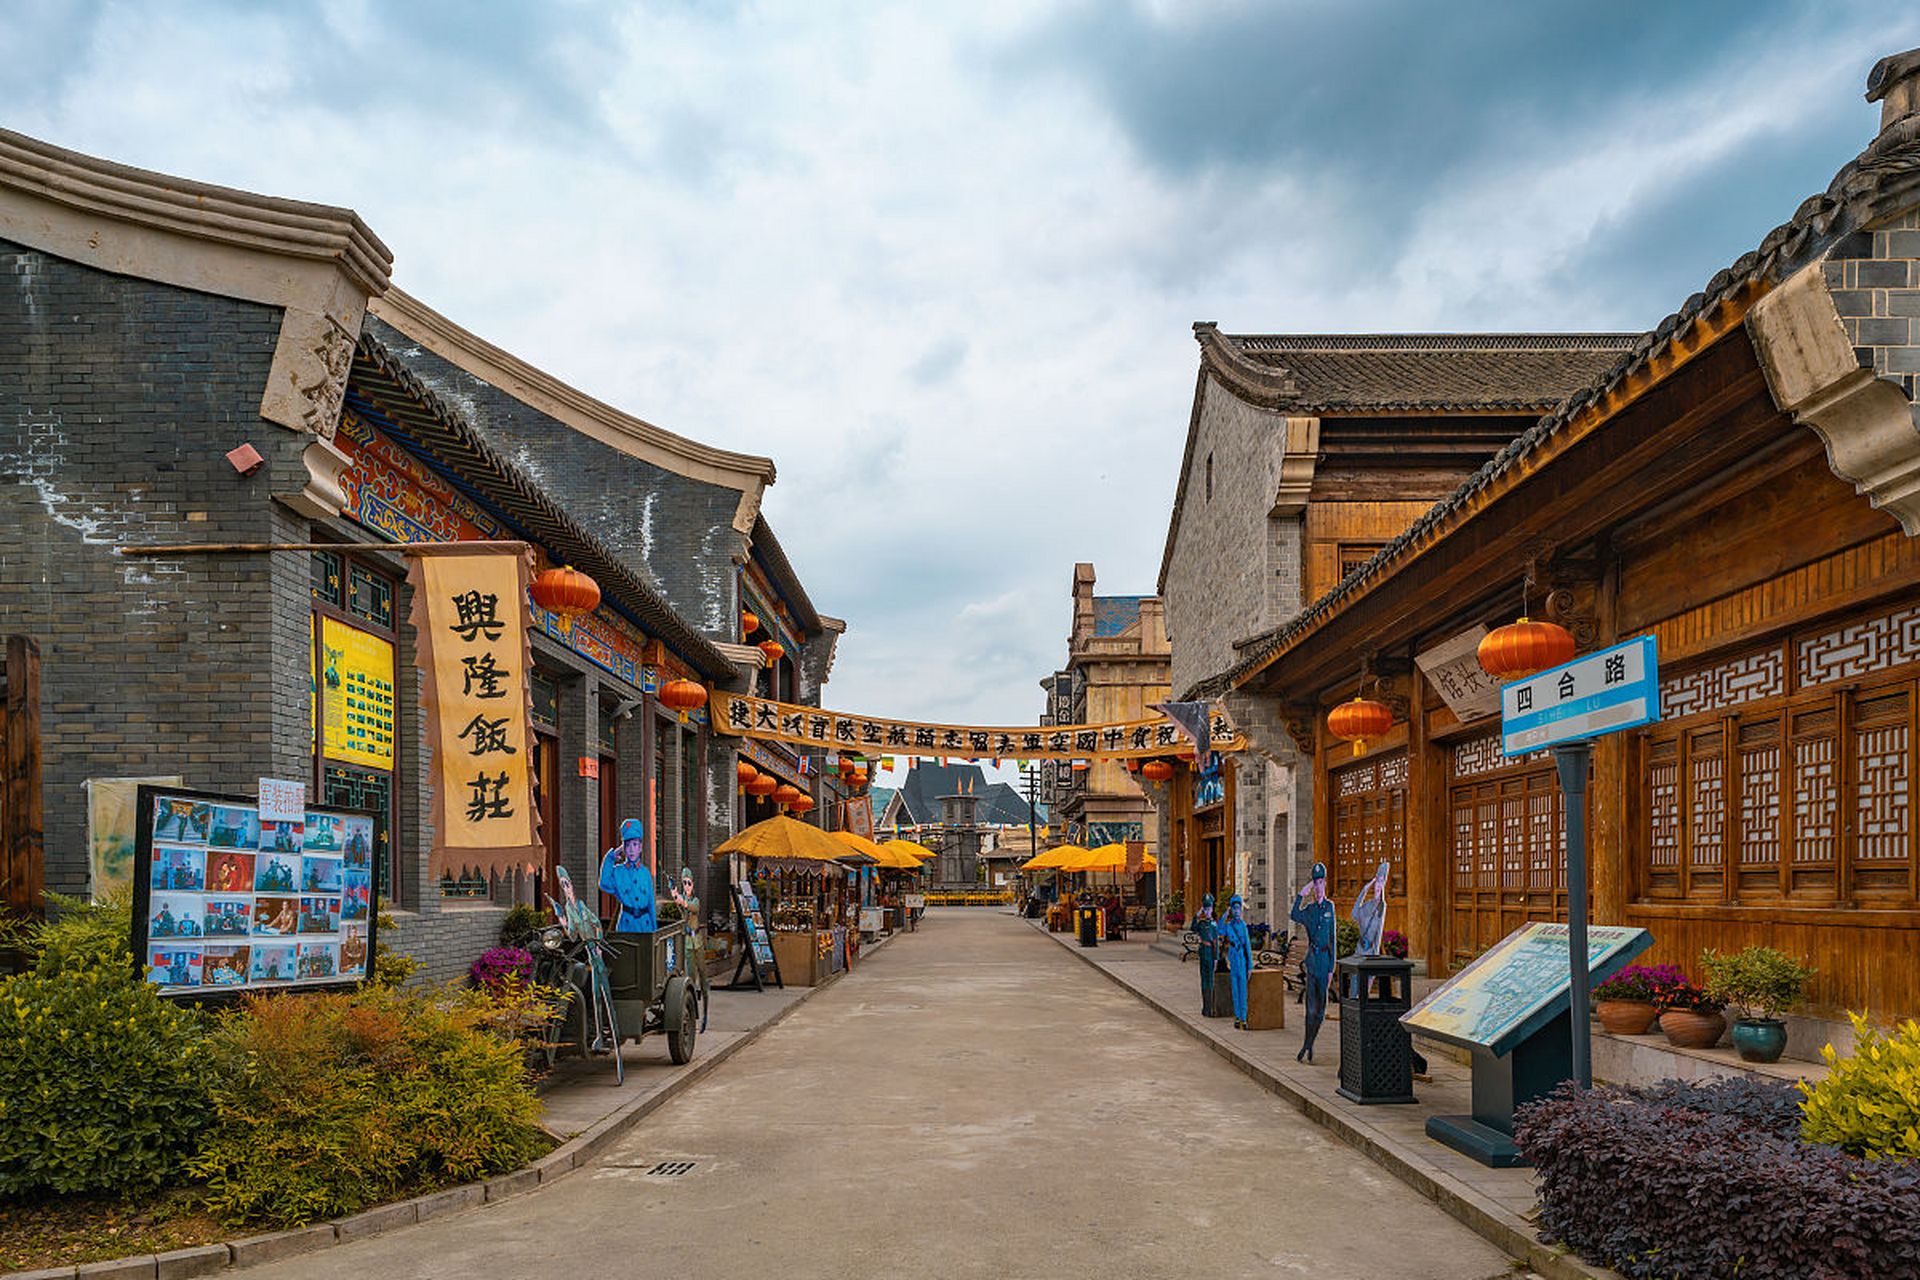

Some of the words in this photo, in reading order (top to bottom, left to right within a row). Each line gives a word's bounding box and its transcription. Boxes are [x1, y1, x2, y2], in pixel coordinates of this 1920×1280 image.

[449, 589, 517, 822] 興隆飯莊
[1516, 653, 1626, 713] 四合路
[1585, 697, 1602, 711] LU
